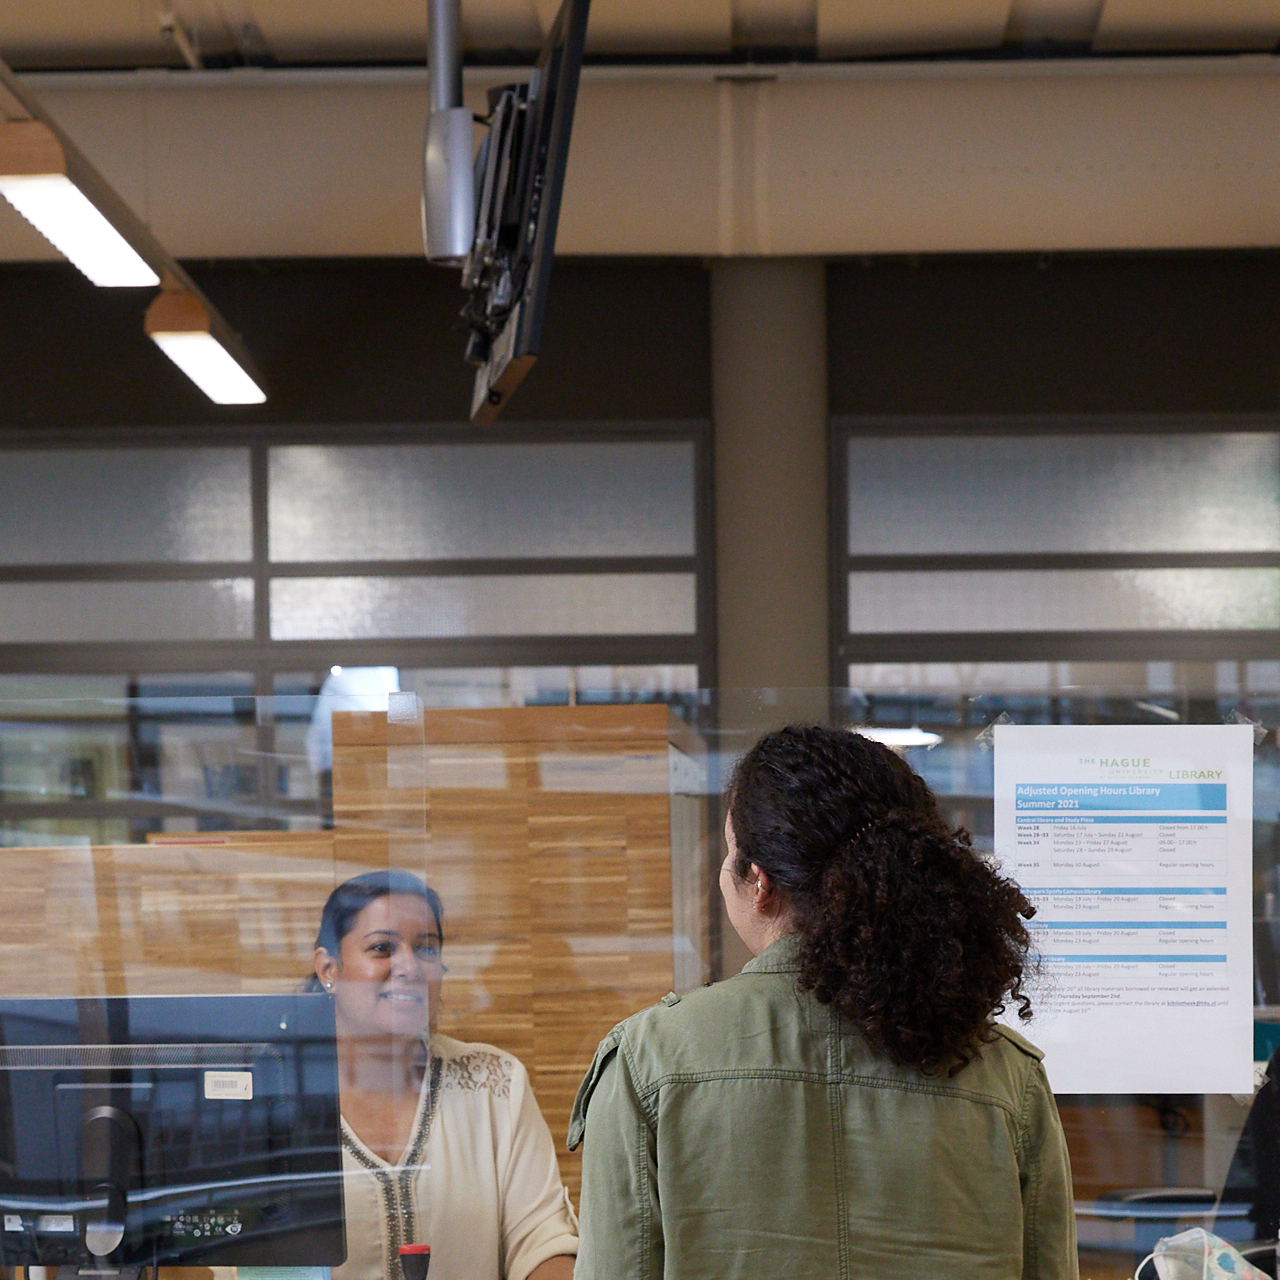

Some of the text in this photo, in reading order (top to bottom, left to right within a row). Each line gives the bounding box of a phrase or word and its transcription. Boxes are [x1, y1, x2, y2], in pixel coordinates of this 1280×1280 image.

[1100, 758, 1151, 768] HAGUE
[1169, 770, 1223, 780] LIBRARY
[1016, 786, 1161, 797] Adjusted Opening Hours Library
[1016, 799, 1080, 809] Summer 2021
